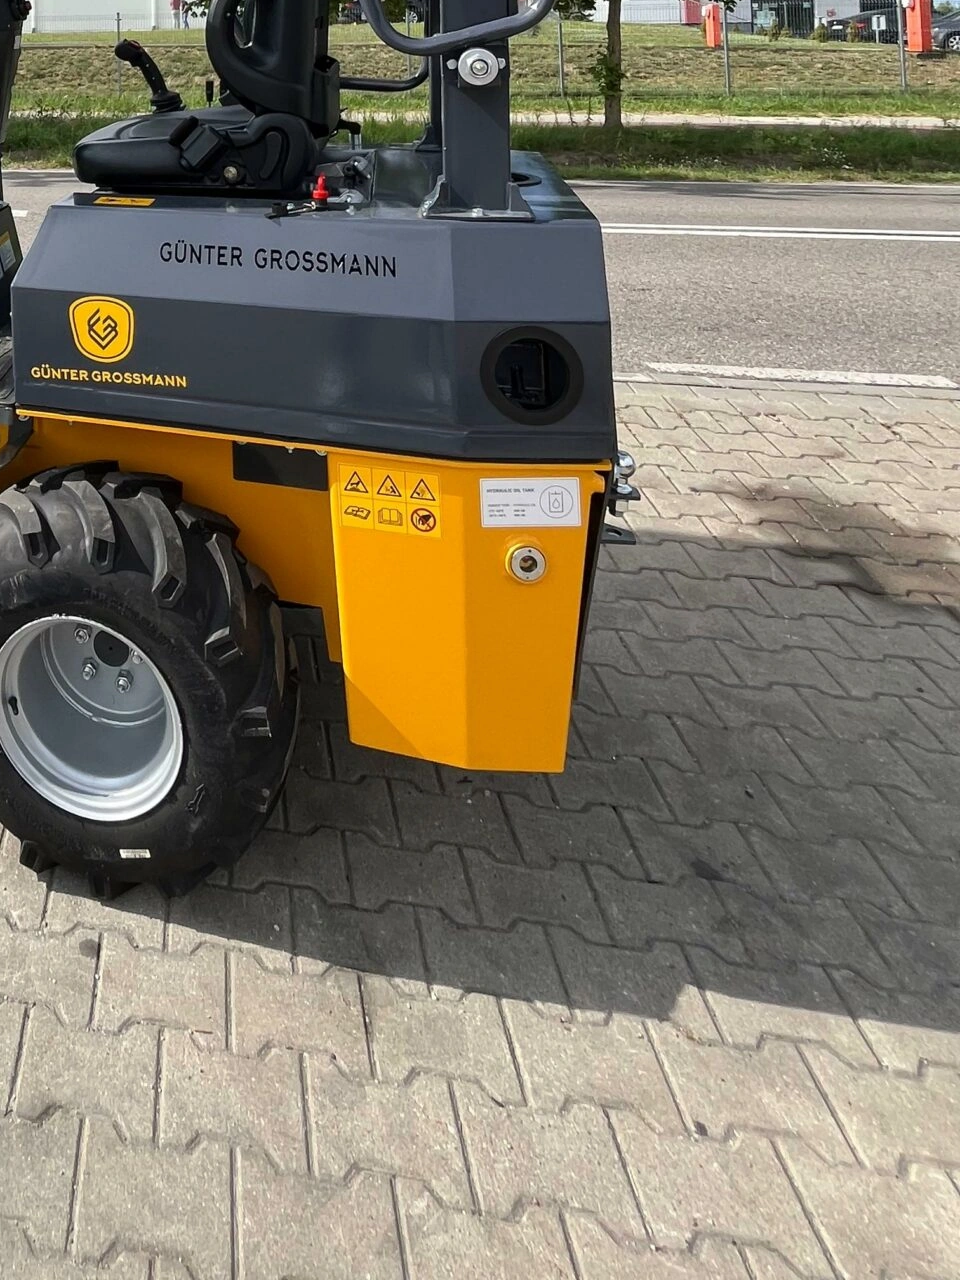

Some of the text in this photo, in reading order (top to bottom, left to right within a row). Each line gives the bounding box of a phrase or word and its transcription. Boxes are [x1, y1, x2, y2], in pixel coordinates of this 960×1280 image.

[159, 239, 397, 277] GÜNTER GROSSMANN
[30, 364, 187, 388] GÜNTER GROSSMANN
